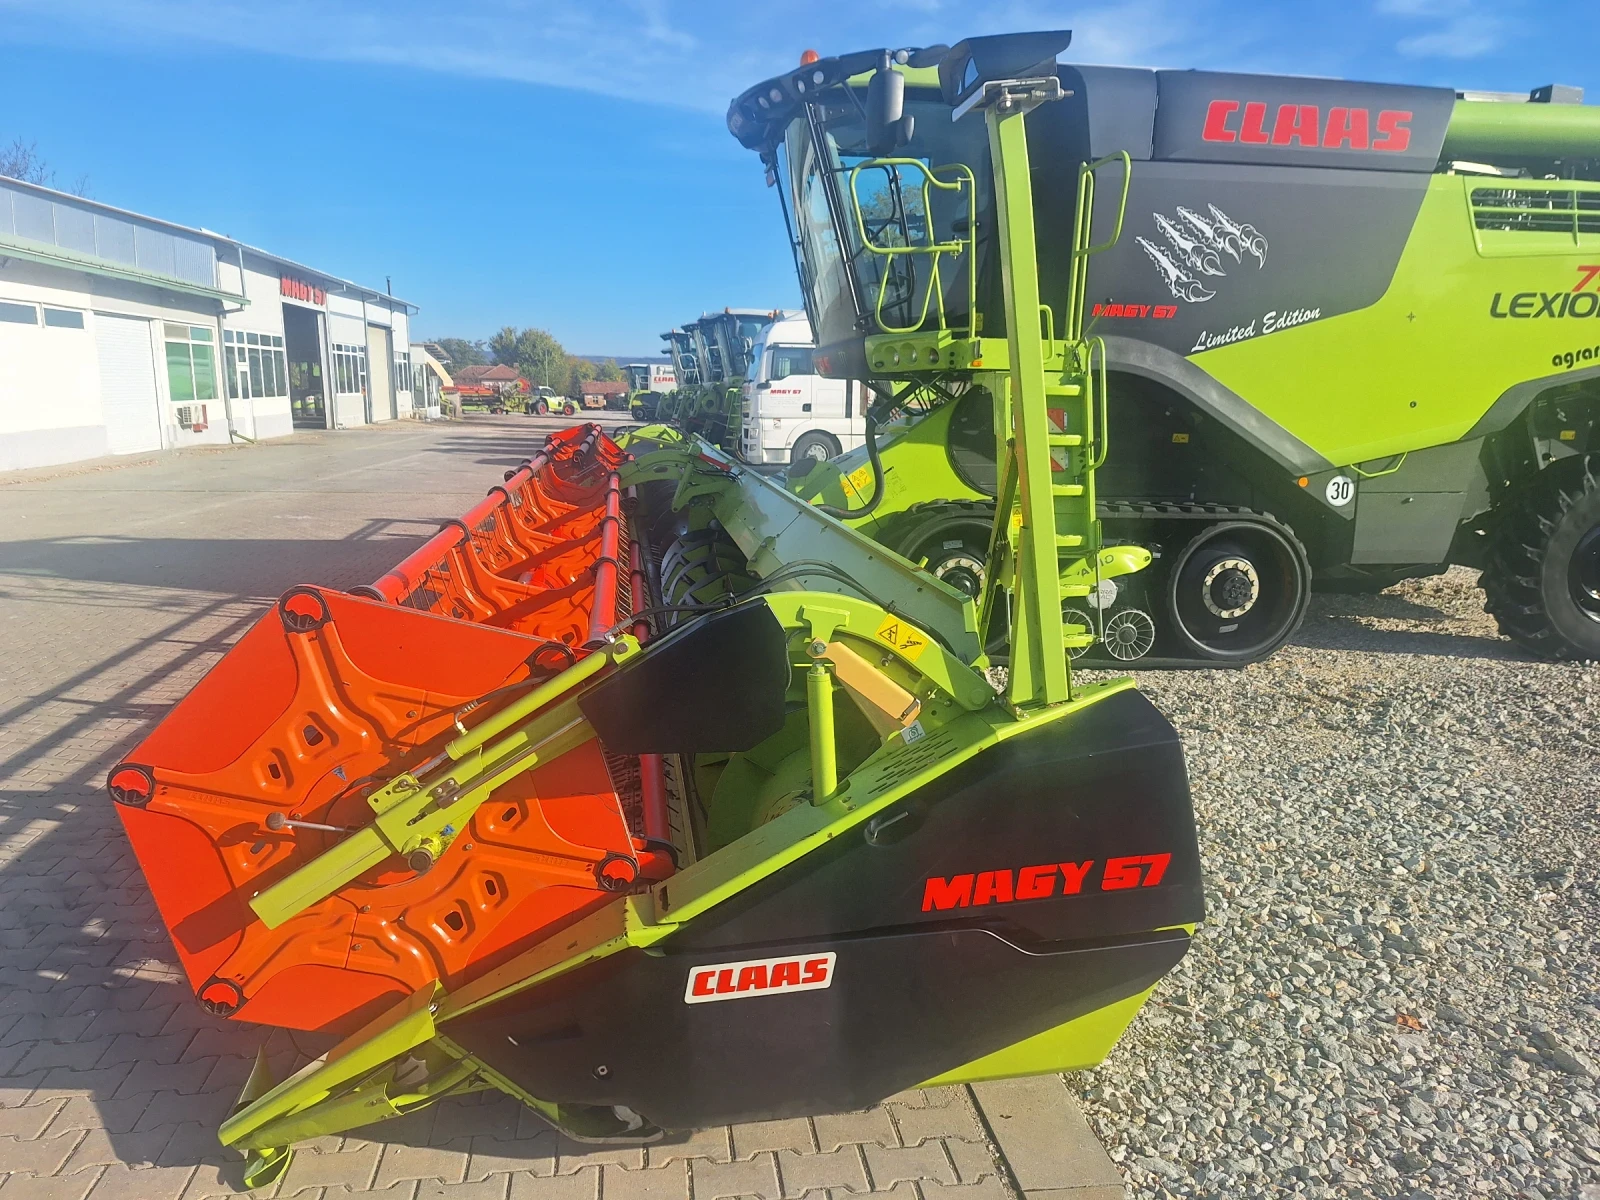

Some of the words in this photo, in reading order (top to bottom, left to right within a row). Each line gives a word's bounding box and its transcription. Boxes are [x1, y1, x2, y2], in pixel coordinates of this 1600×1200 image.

[1202, 99, 1413, 152] CLAAS
[1571, 265, 1600, 292] 7
[1092, 303, 1151, 318] MAGY
[1152, 305, 1177, 319] 57
[1490, 292, 1600, 318] LEXIO
[1191, 319, 1255, 353] Limited
[1261, 306, 1321, 334] Edition
[1330, 481, 1350, 500] 30
[922, 860, 1095, 911] MAGY
[1102, 853, 1172, 890] 57
[692, 958, 828, 996] CLAAS
